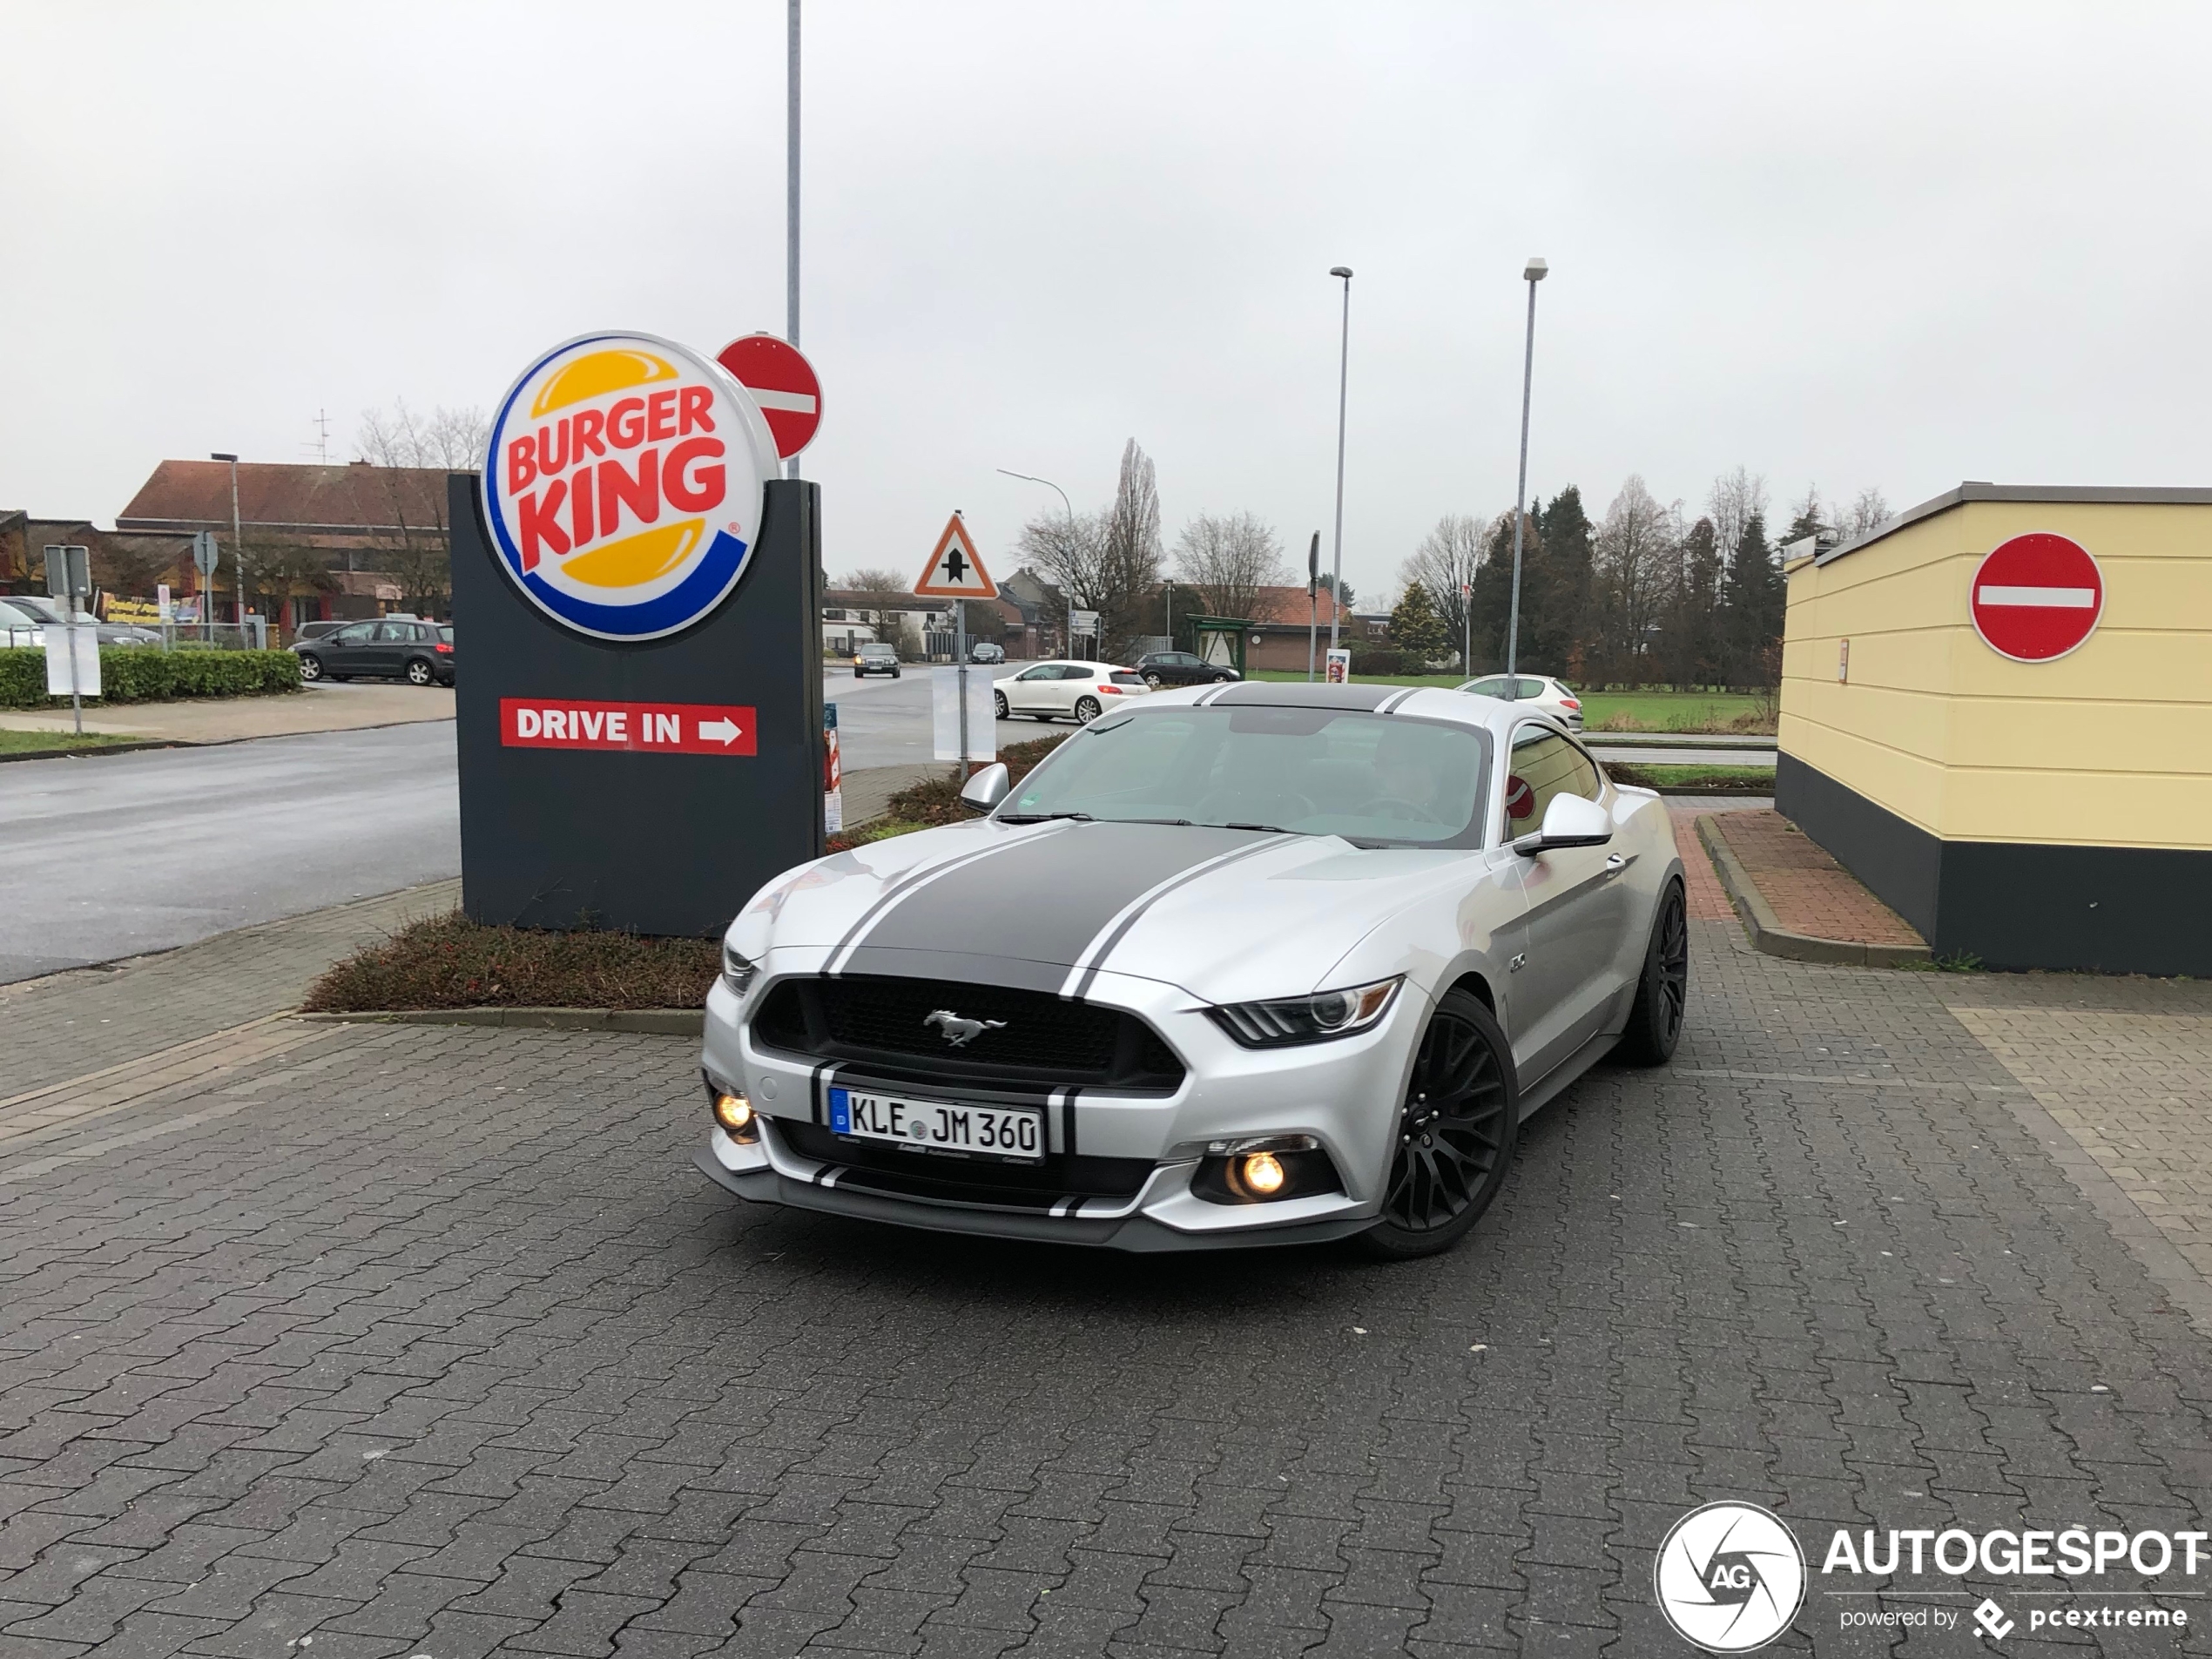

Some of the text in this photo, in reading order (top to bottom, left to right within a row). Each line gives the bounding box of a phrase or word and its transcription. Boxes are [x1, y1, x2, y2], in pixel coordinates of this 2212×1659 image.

[509, 386, 716, 496] BURGER
[518, 436, 726, 572] KING
[517, 708, 680, 744] DRIVE IN
[851, 1096, 1035, 1151] KLE JM 360
